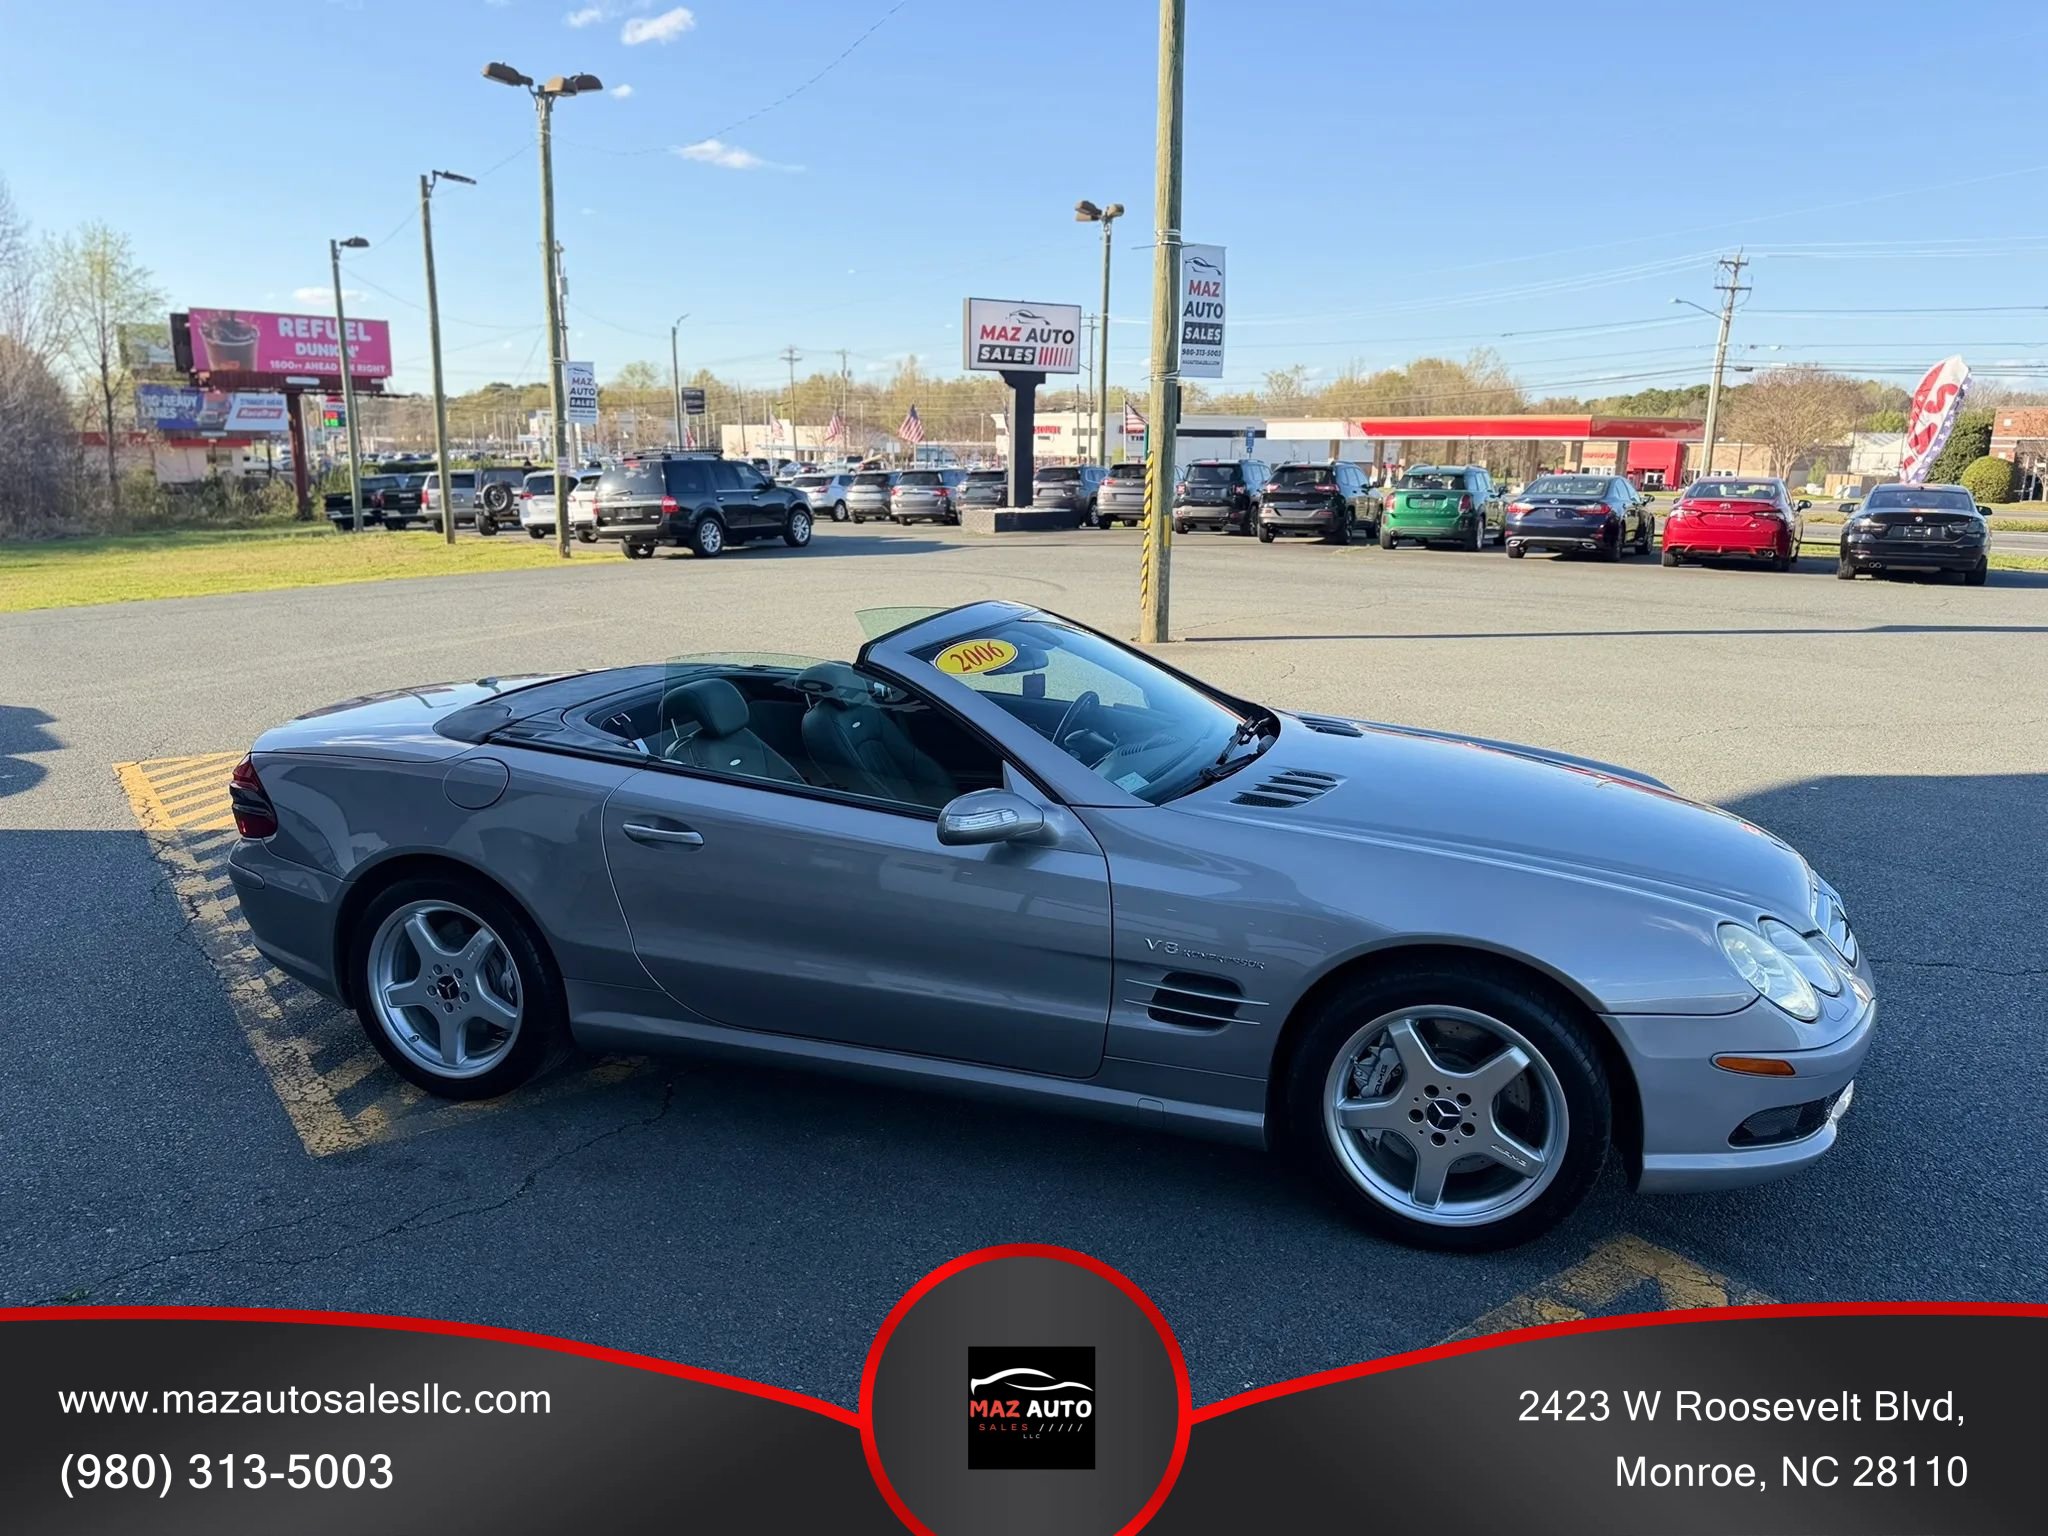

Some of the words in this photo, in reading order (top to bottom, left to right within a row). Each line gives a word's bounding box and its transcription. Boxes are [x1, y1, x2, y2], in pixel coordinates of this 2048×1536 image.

[1188, 279, 1221, 298] MAZ
[1182, 301, 1224, 319] AUTO
[277, 316, 373, 342] REFUEL
[980, 324, 1022, 342] MAZ
[1024, 328, 1075, 345] AUTO
[1184, 326, 1222, 341] SALES
[979, 346, 1035, 361] SALES
[304, 361, 338, 372] AHEAD
[572, 378, 592, 386] MAZ
[569, 388, 596, 396] AUTO
[950, 640, 1005, 672] 2006
[1145, 937, 1179, 954] V8
